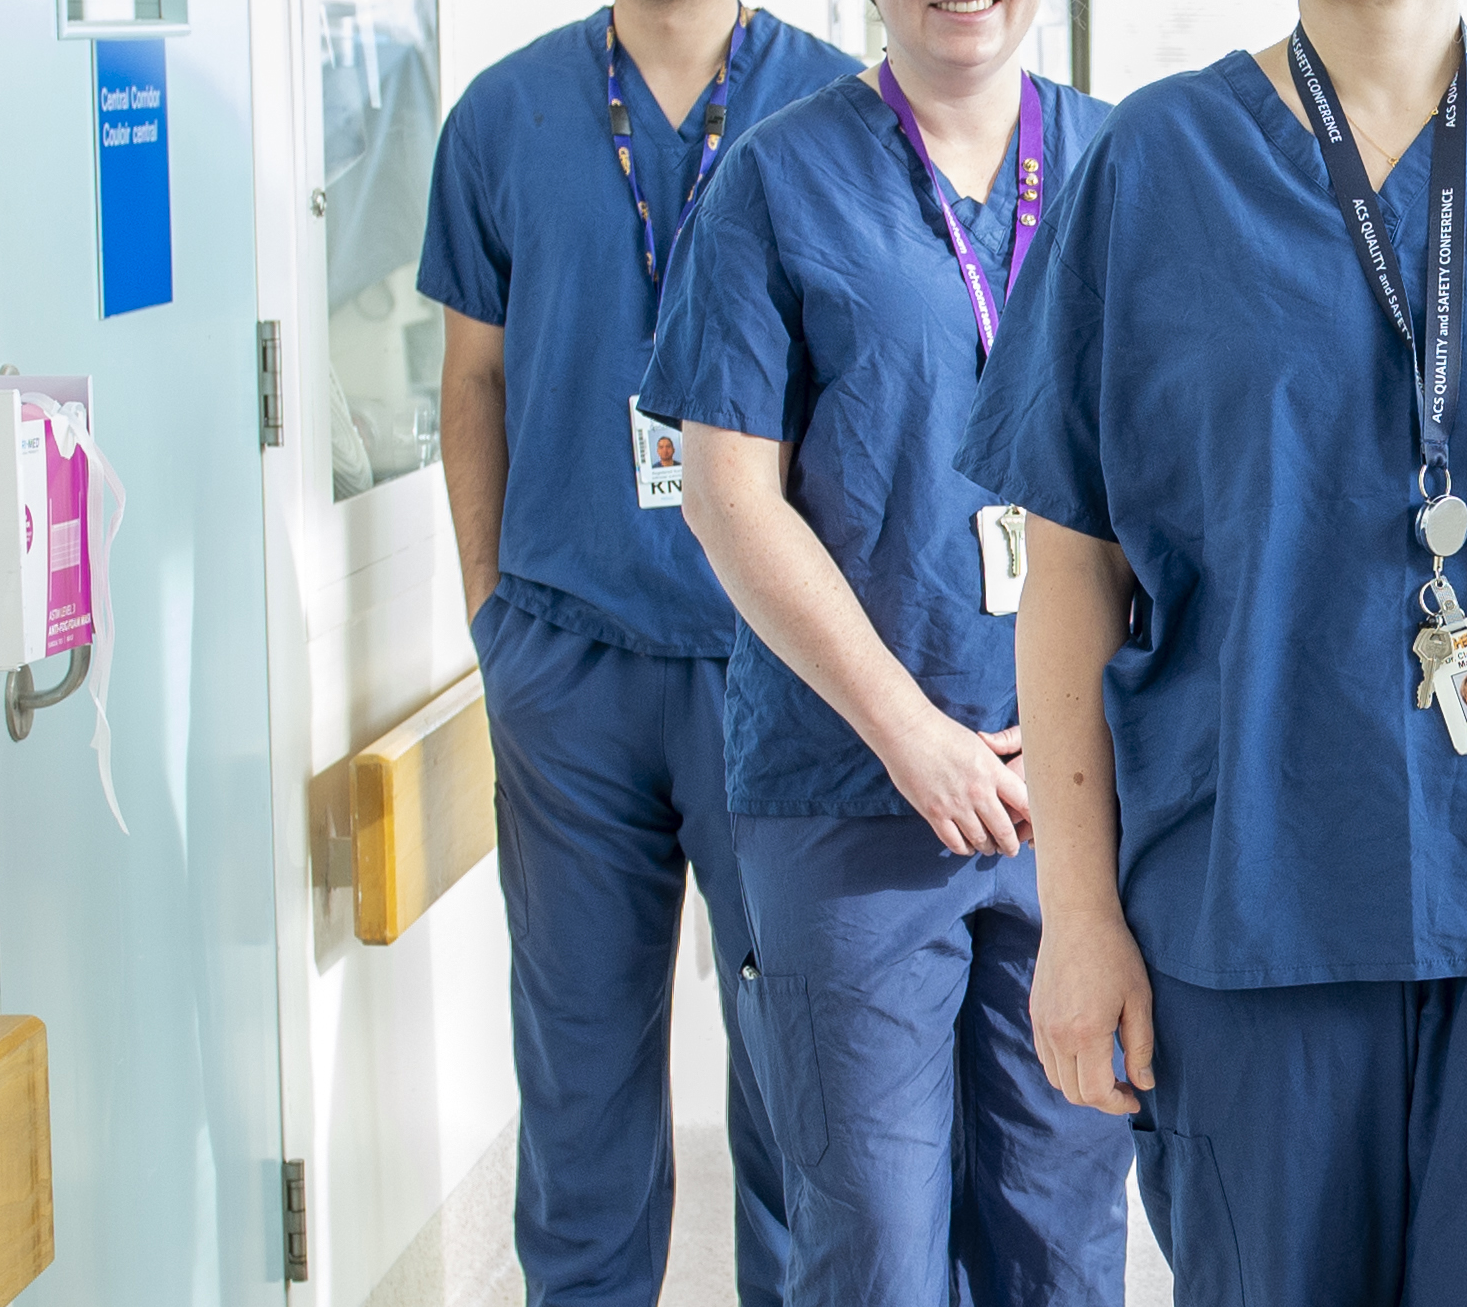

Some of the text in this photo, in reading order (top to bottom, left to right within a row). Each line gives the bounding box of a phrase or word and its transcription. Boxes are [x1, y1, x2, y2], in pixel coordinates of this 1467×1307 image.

[100, 85, 160, 112] Central Corridor
[1293, 43, 1315, 78] SAFETY
[1307, 77, 1343, 144] CONFERENCE
[1445, 102, 1457, 128] ACS
[103, 118, 158, 147] Couloir central
[1352, 198, 1370, 222] ACS
[1360, 220, 1387, 271] QUALITY
[1378, 273, 1395, 296] and
[1432, 187, 1454, 423] ACS QUALITY and SAFETY CONFERENCE
[21, 437, 40, 449] RI-MED
